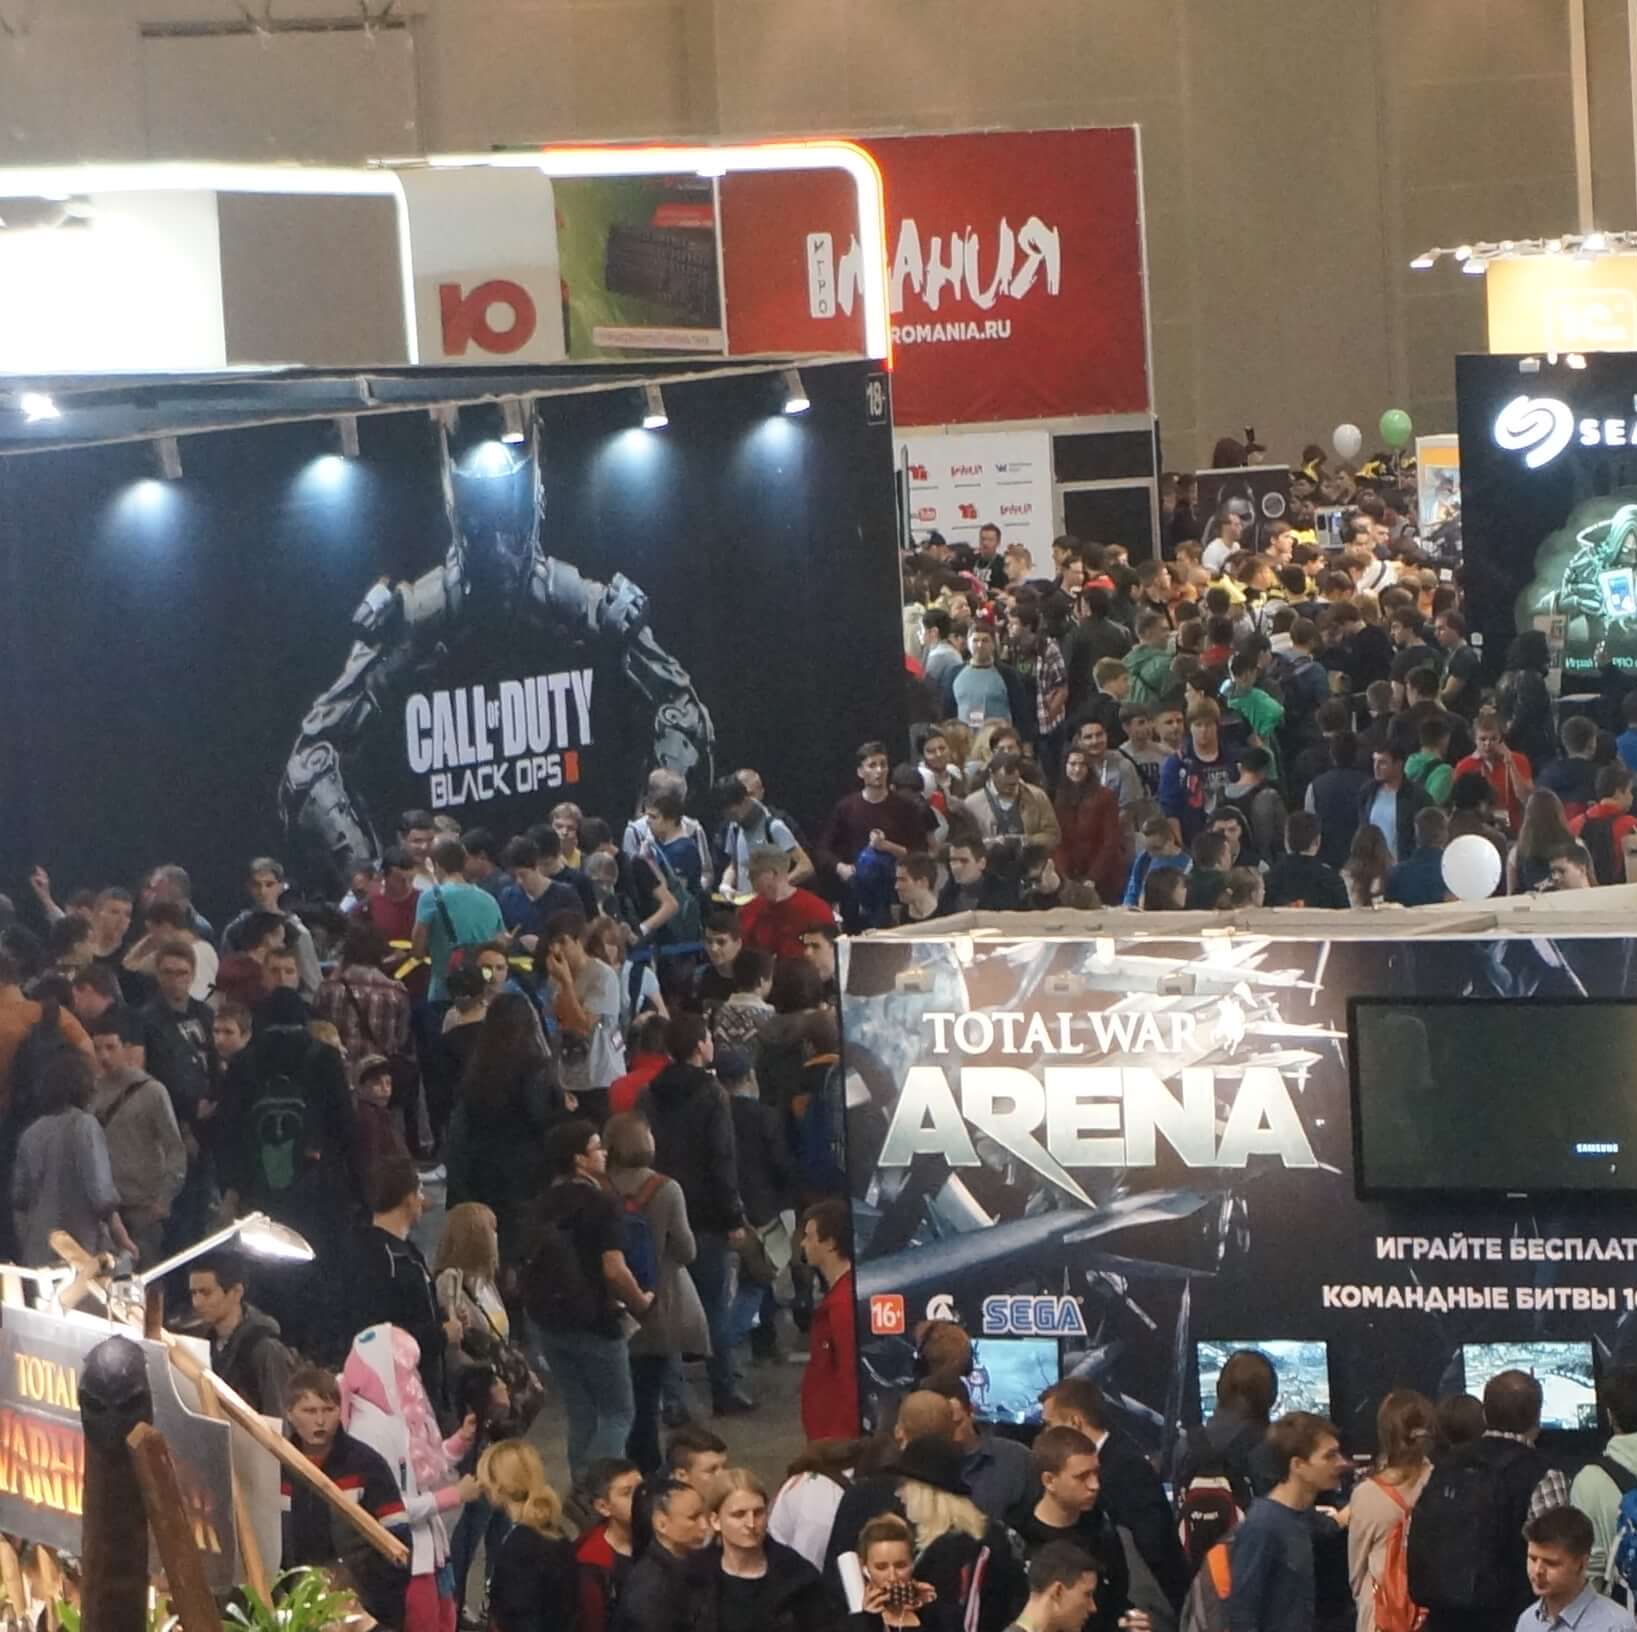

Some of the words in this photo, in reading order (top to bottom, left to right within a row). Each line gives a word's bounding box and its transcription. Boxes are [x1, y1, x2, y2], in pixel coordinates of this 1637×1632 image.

[405, 685, 494, 774] CALL
[499, 668, 593, 757] DUTY
[431, 763, 511, 809] BLACK
[516, 754, 562, 793] OPS
[922, 1011, 1083, 1055] TOTAL
[1086, 1010, 1199, 1054] WAR
[877, 1065, 1319, 1208] ARENA
[1376, 1234, 1503, 1261] ИГРАЙТЕ
[982, 1295, 1087, 1334] SEGA
[1323, 1285, 1510, 1313] КОМАНДНЫЕ
[1516, 1287, 1616, 1313] БИТВЫ
[15, 1351, 81, 1412] TOTAL
